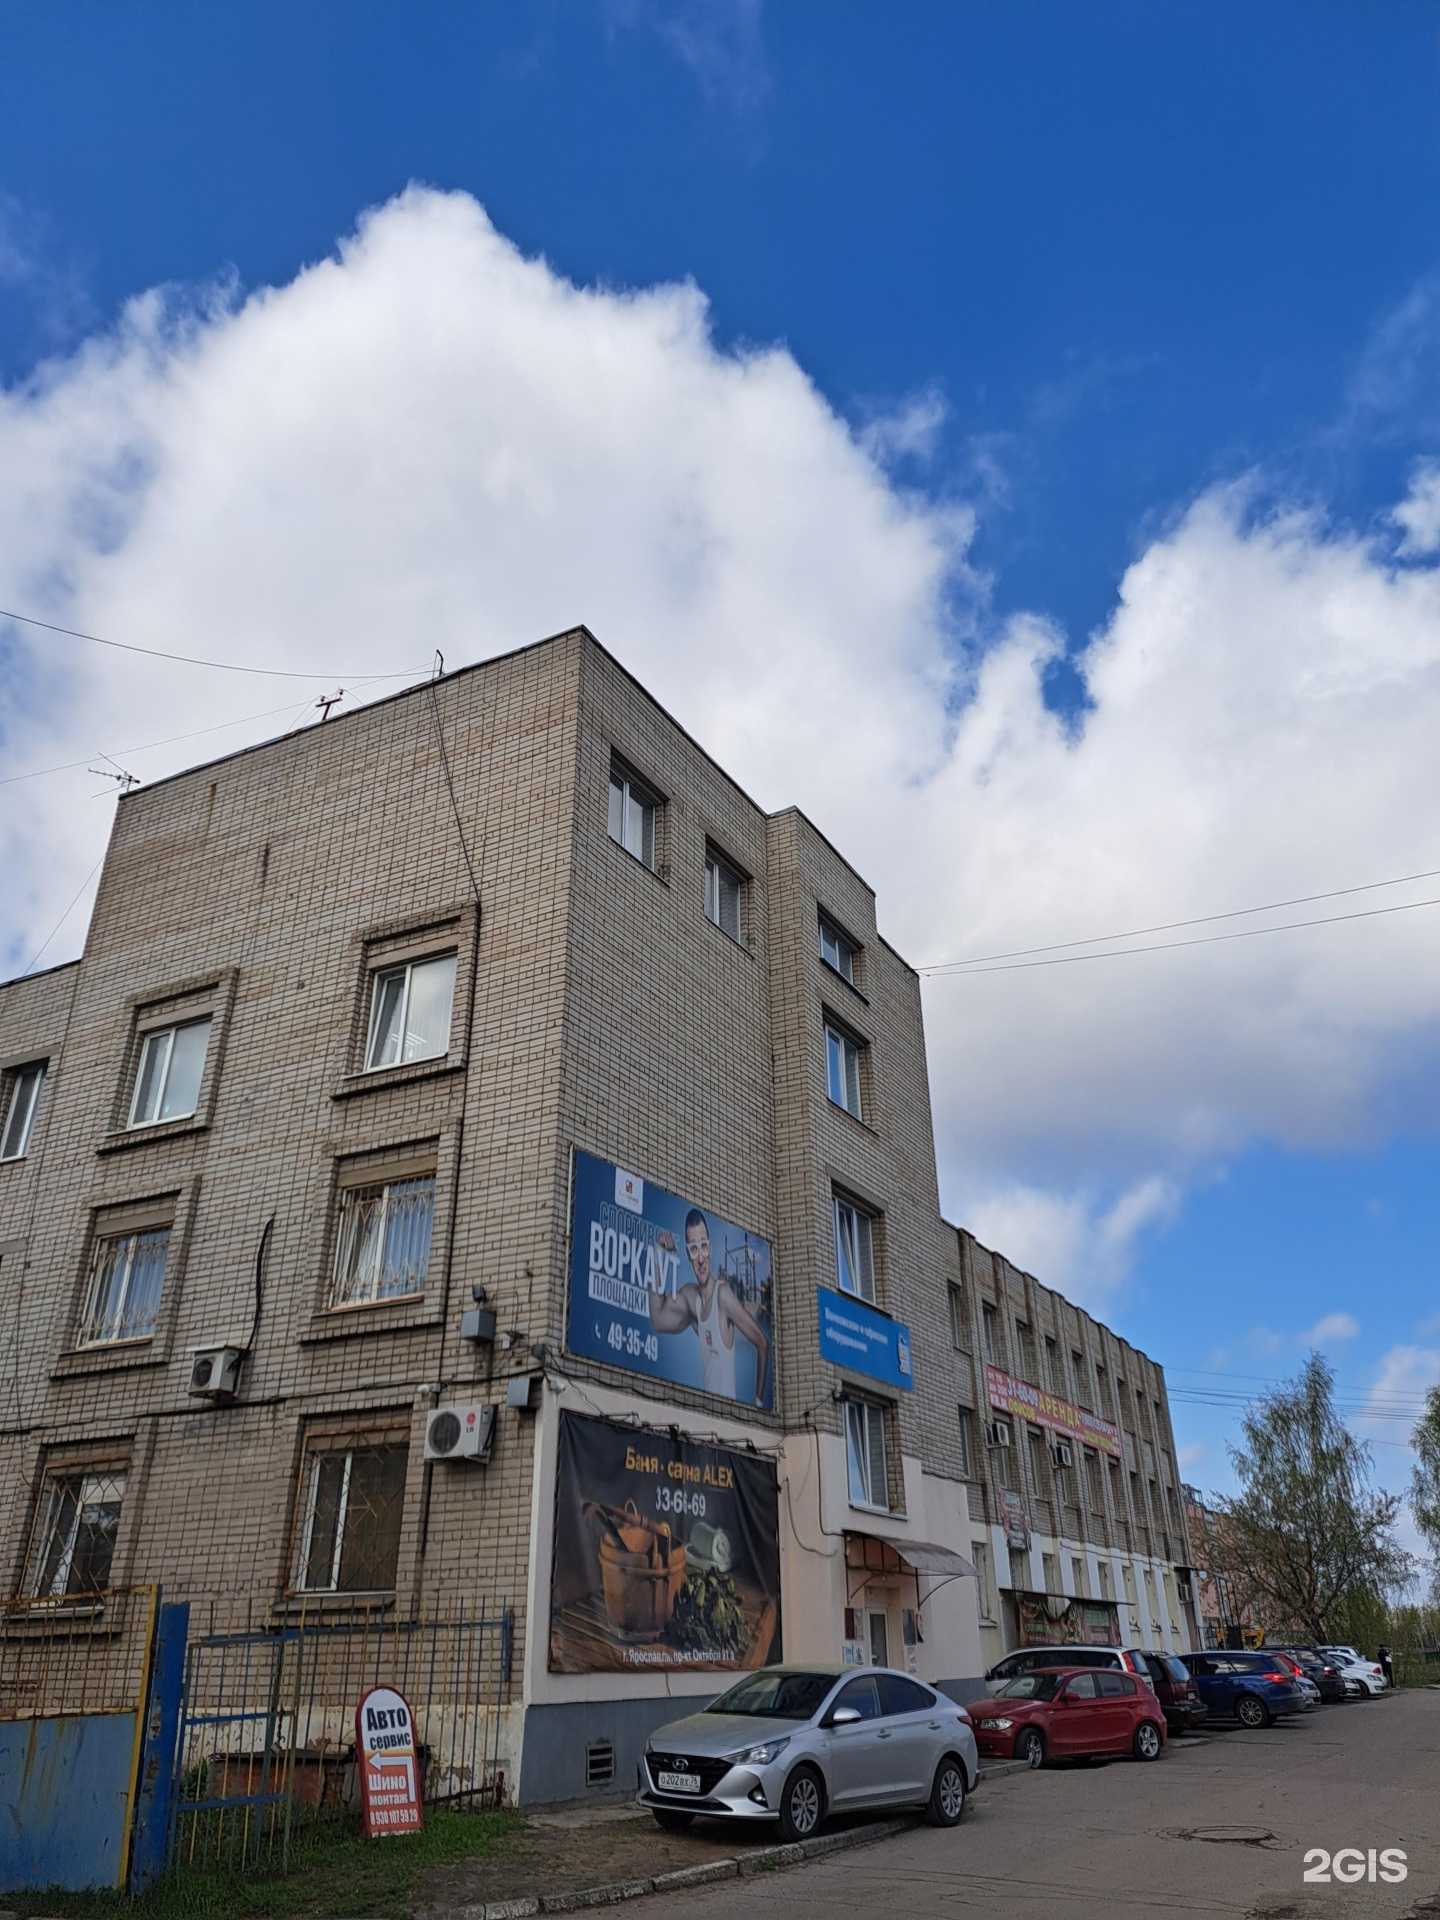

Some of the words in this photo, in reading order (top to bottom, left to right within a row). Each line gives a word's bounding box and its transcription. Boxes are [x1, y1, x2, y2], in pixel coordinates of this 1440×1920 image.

[589, 1221, 680, 1300] ВОРКАУТ
[592, 1274, 649, 1315] ПЛОЩАДКИ
[607, 1322, 659, 1362] 49-35-49
[624, 1446, 659, 1474] Баня
[703, 1464, 734, 1488] ALEX
[370, 1732, 411, 1750] сервис
[369, 1774, 406, 1791] Шино
[369, 1793, 408, 1806] монтаж
